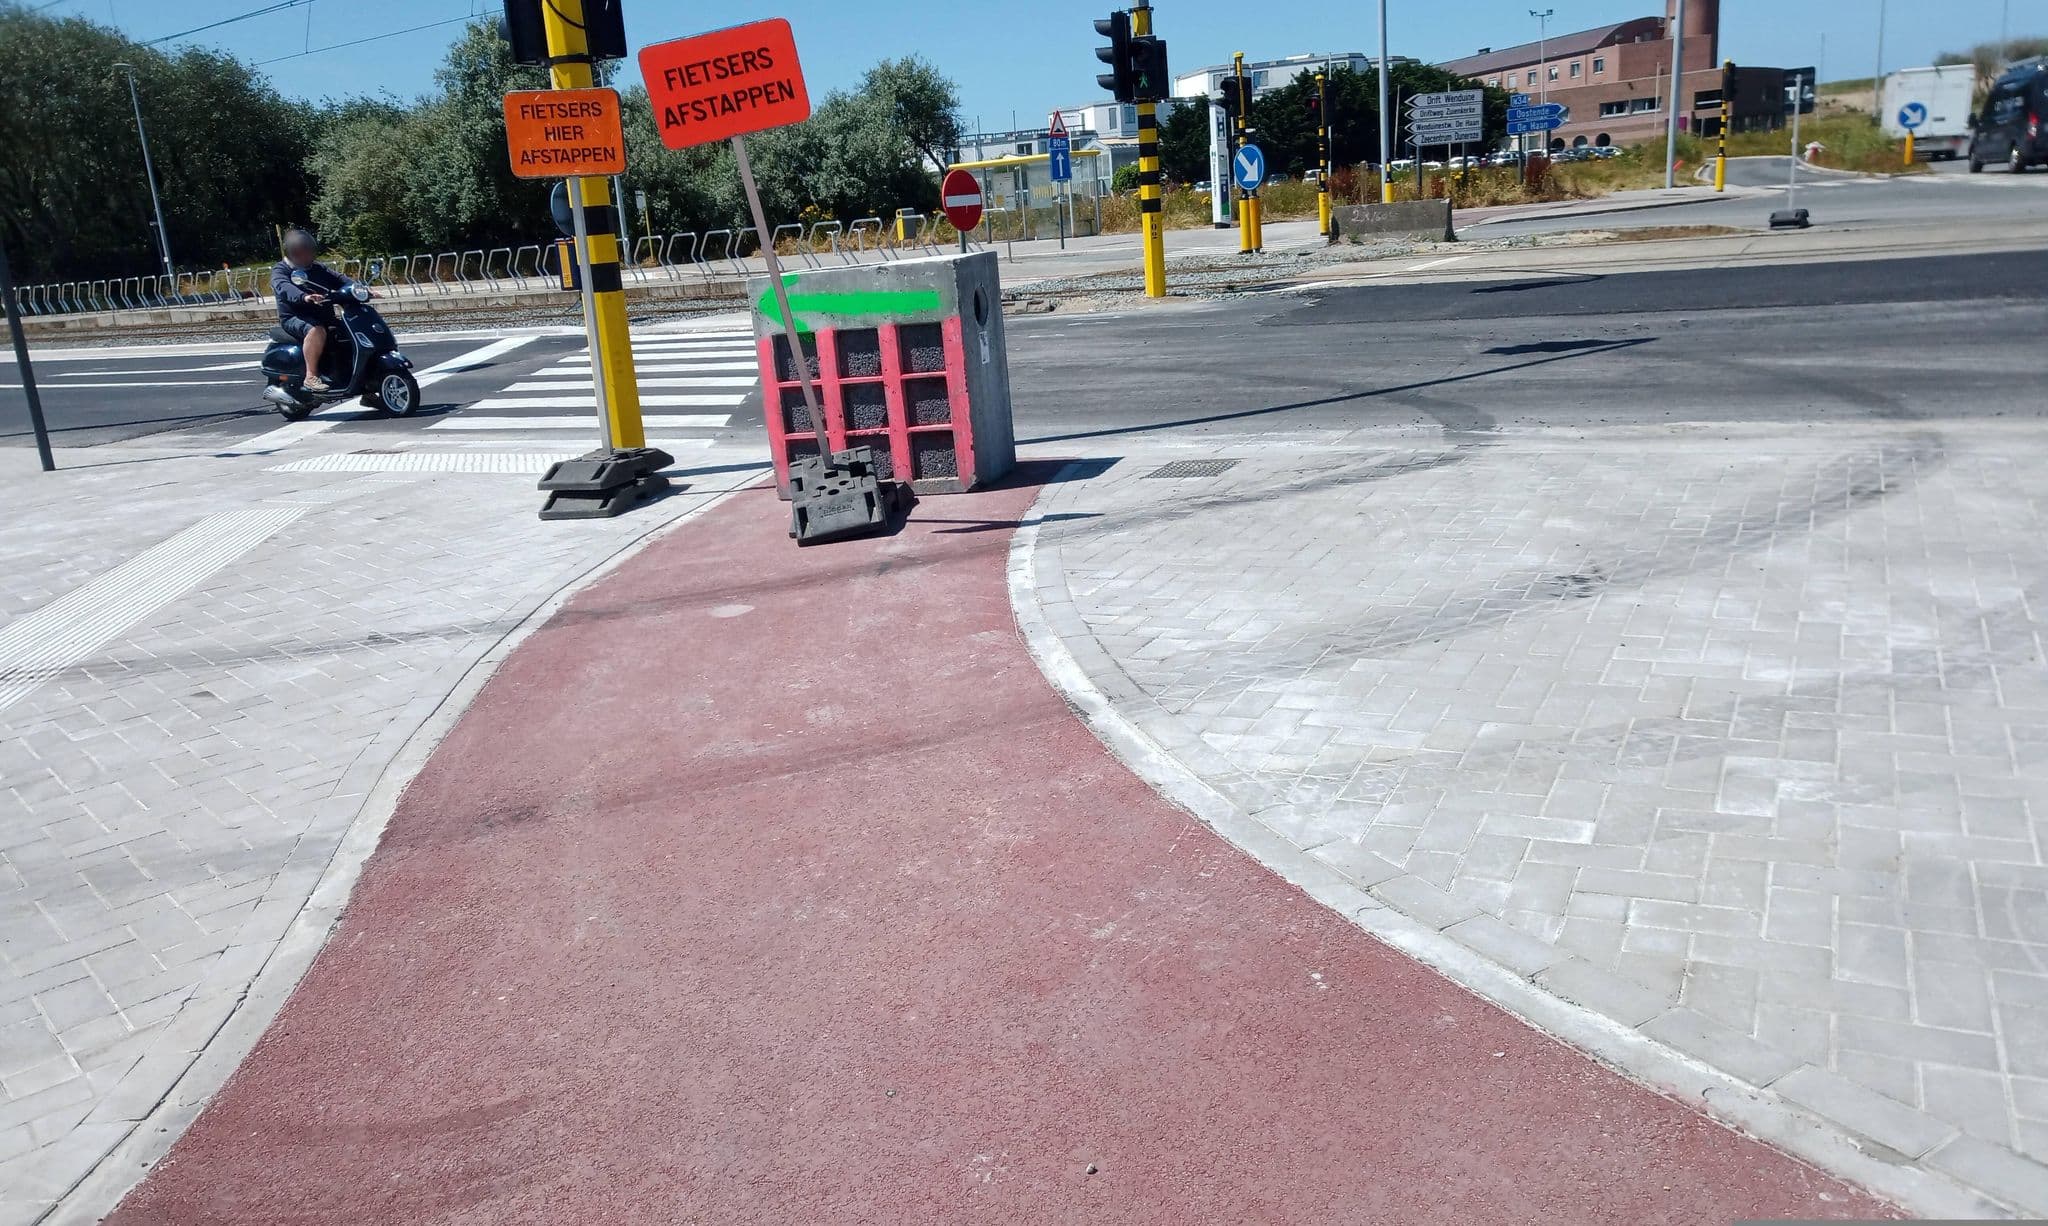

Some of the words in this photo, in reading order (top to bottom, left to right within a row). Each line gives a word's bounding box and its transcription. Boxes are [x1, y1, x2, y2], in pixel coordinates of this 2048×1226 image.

[664, 47, 774, 91] FIETSERS
[664, 78, 795, 129] AFSTAPPEN
[1444, 93, 1475, 103] Wenduine
[520, 101, 602, 120] FIETSERS
[1419, 109, 1443, 118] Driftweg
[1516, 107, 1549, 118] Oostende
[1465, 119, 1480, 127] Haan
[1517, 123, 1527, 132] De
[1530, 121, 1548, 130] Haan
[544, 126, 584, 141] HIER
[1421, 133, 1452, 143] Zeecentrum
[520, 147, 616, 165] AFSTAPPEN
